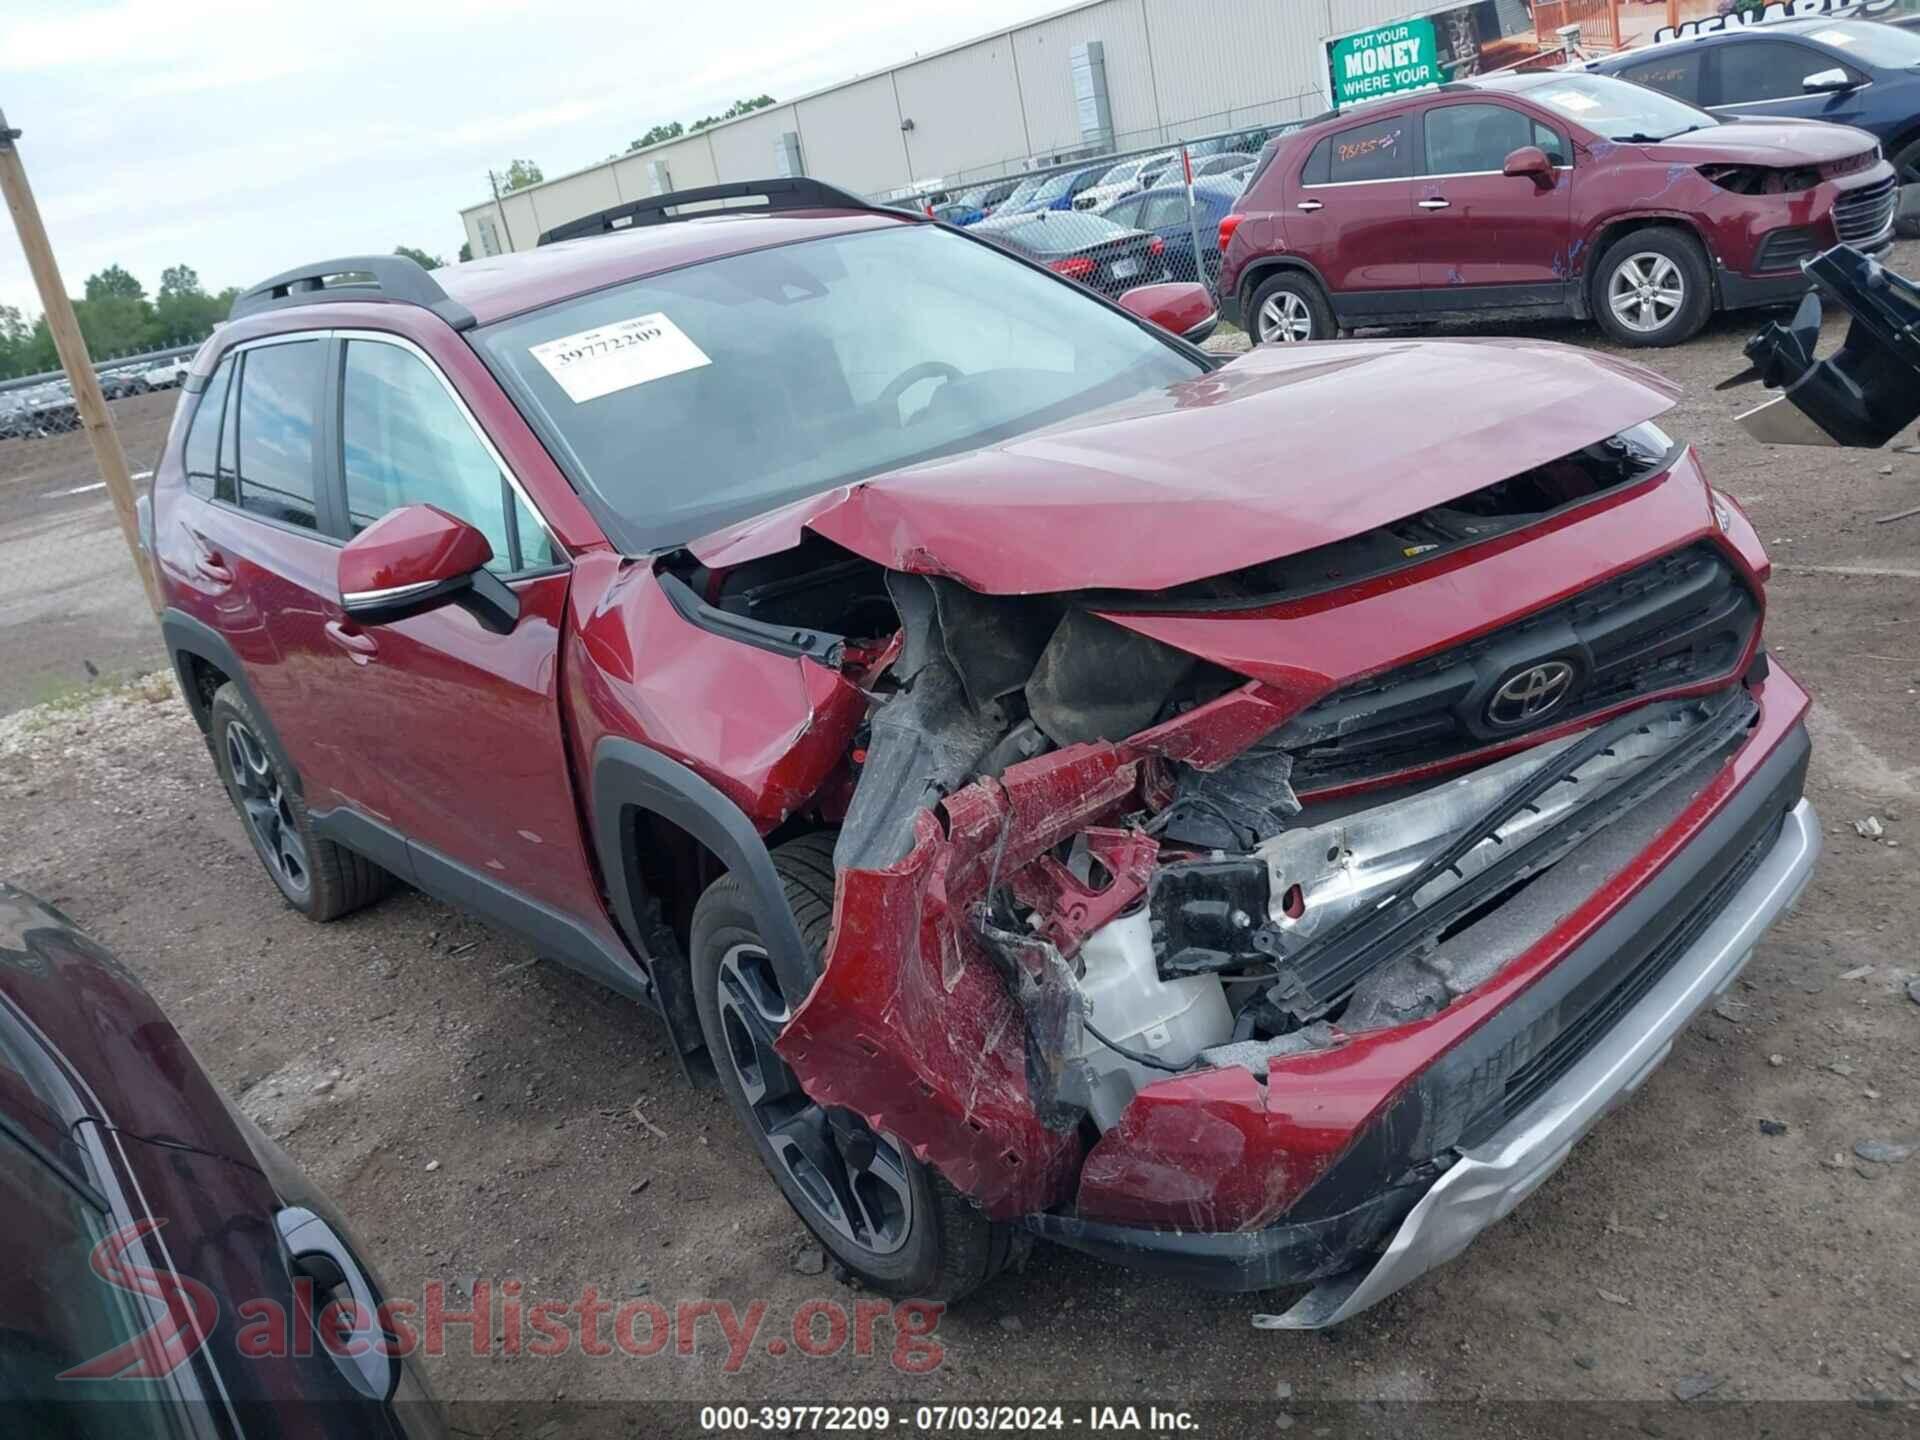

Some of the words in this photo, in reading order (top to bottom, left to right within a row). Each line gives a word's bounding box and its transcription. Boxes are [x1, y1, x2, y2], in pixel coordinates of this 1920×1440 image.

[1352, 35, 1375, 50] PUT
[1376, 26, 1409, 43] YOUR
[1344, 37, 1421, 78] MONEY
[1343, 73, 1392, 96] WHERE
[1393, 65, 1430, 85] YOUR
[555, 327, 662, 366] 39772209
